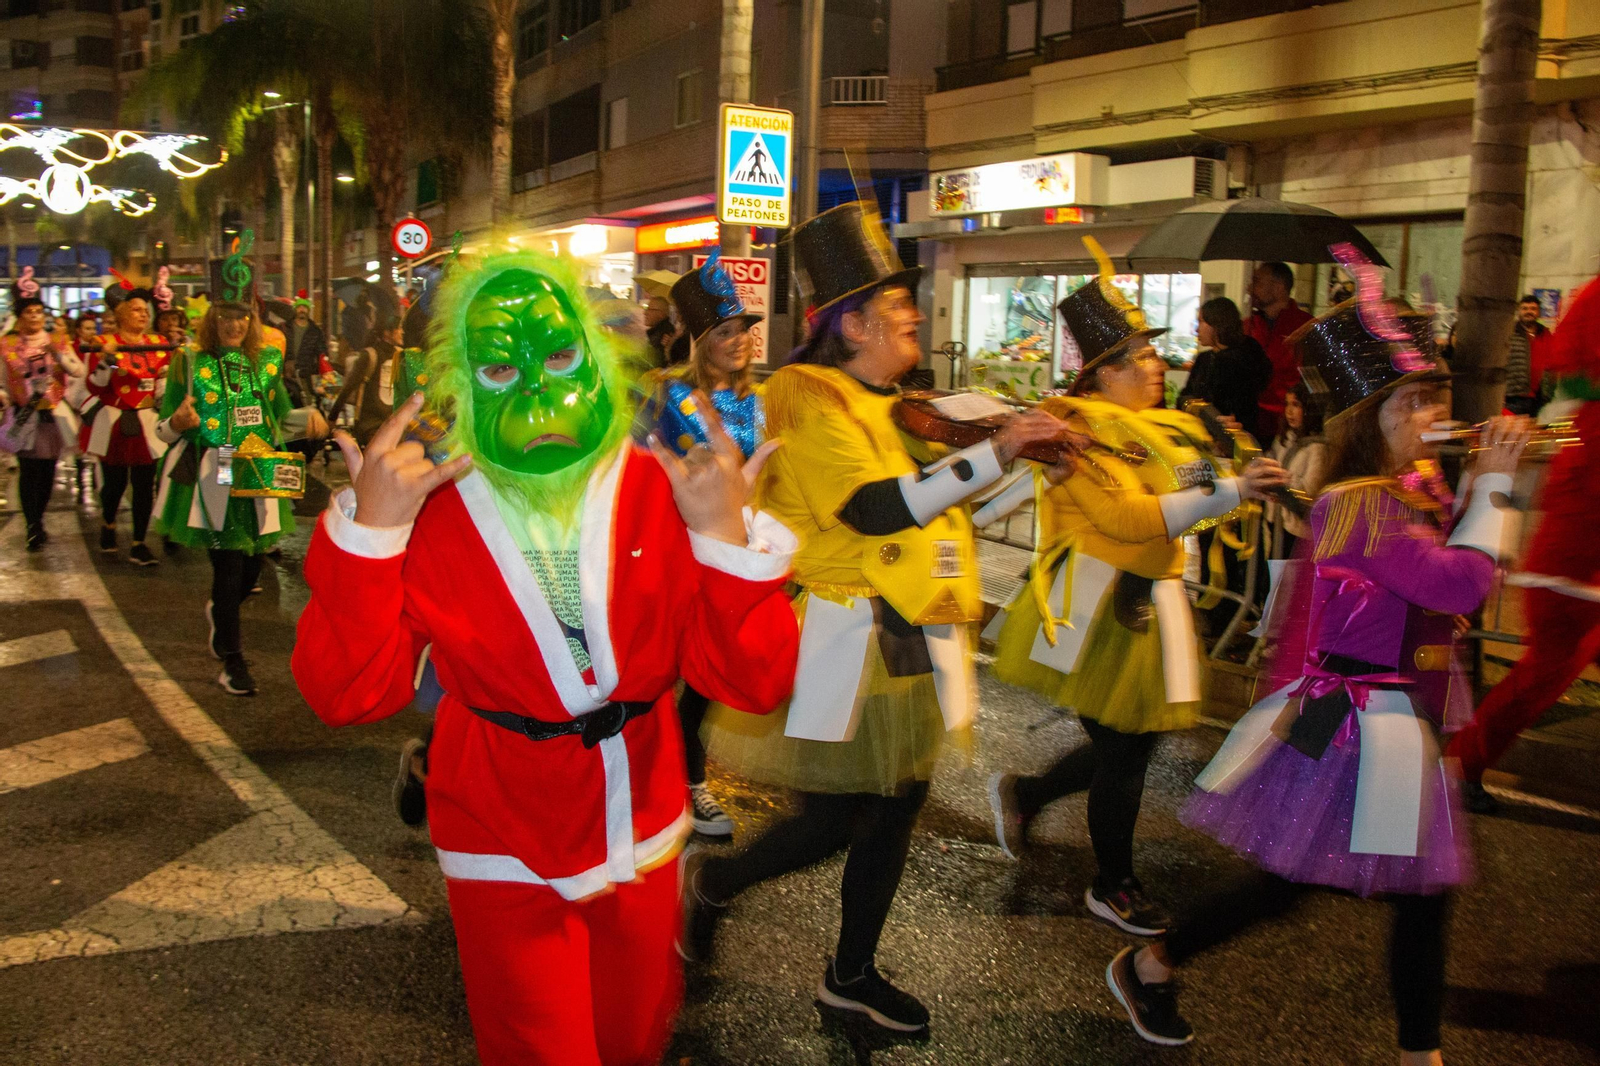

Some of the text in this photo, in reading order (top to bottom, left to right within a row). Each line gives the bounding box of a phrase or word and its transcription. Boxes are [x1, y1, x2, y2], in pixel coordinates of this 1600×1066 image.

[730, 113, 789, 131] ATENCIÓN
[732, 196, 782, 210] PASO DE
[727, 208, 785, 221] PEATONES
[402, 232, 424, 245] 30
[724, 261, 765, 282] ISO
[237, 408, 260, 416] Dando
[243, 416, 259, 424] Nota
